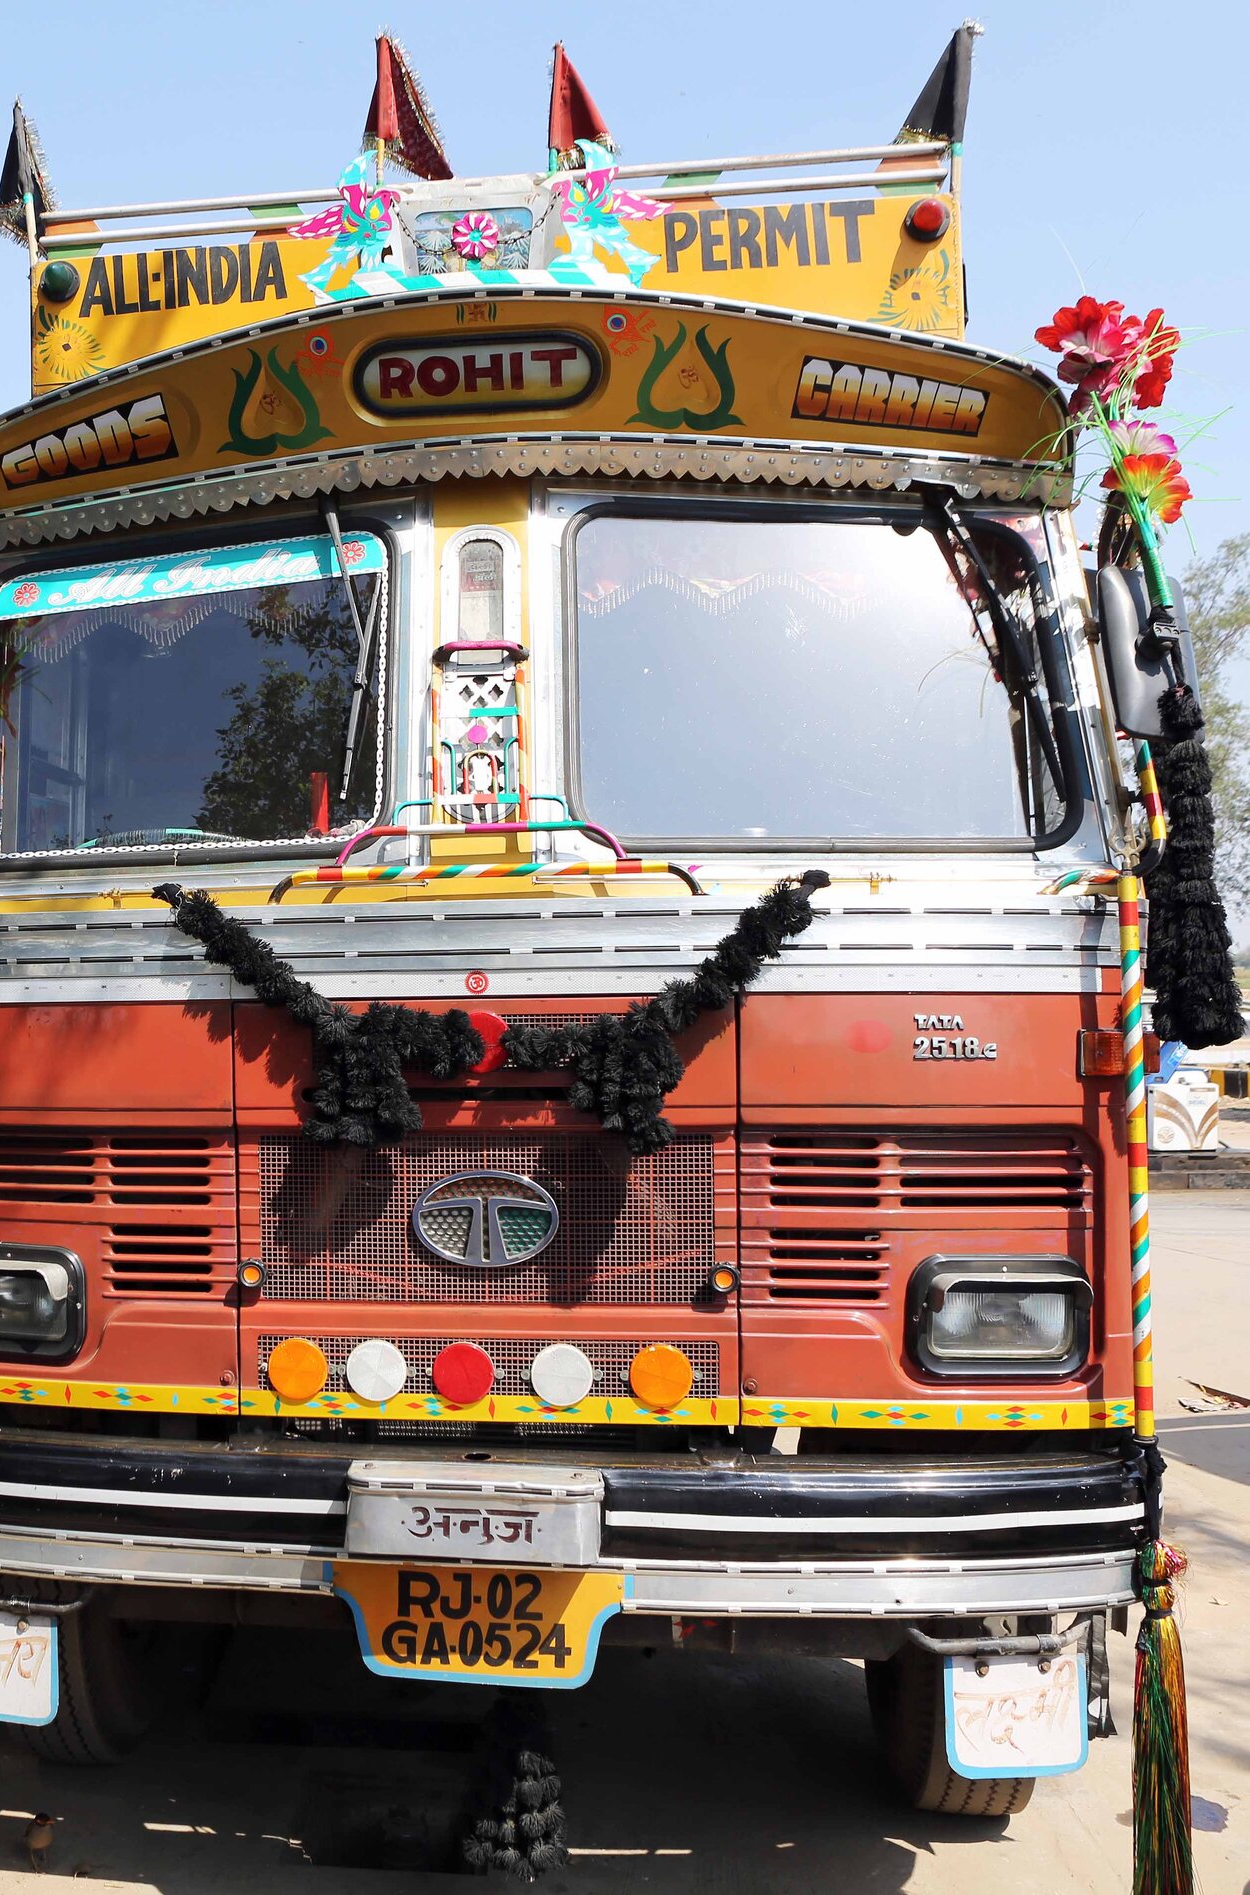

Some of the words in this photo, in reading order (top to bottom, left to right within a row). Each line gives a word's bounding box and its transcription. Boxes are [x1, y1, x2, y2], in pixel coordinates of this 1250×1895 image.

[664, 199, 876, 274] PERMIT
[378, 347, 578, 399] ROHIT
[795, 358, 986, 432] CARRIER
[1, 394, 173, 486] GOODS
[47, 563, 158, 606] All
[152, 547, 321, 593] India
[913, 1013, 964, 1031] TATA
[381, 1619, 572, 1670] GA-0524
